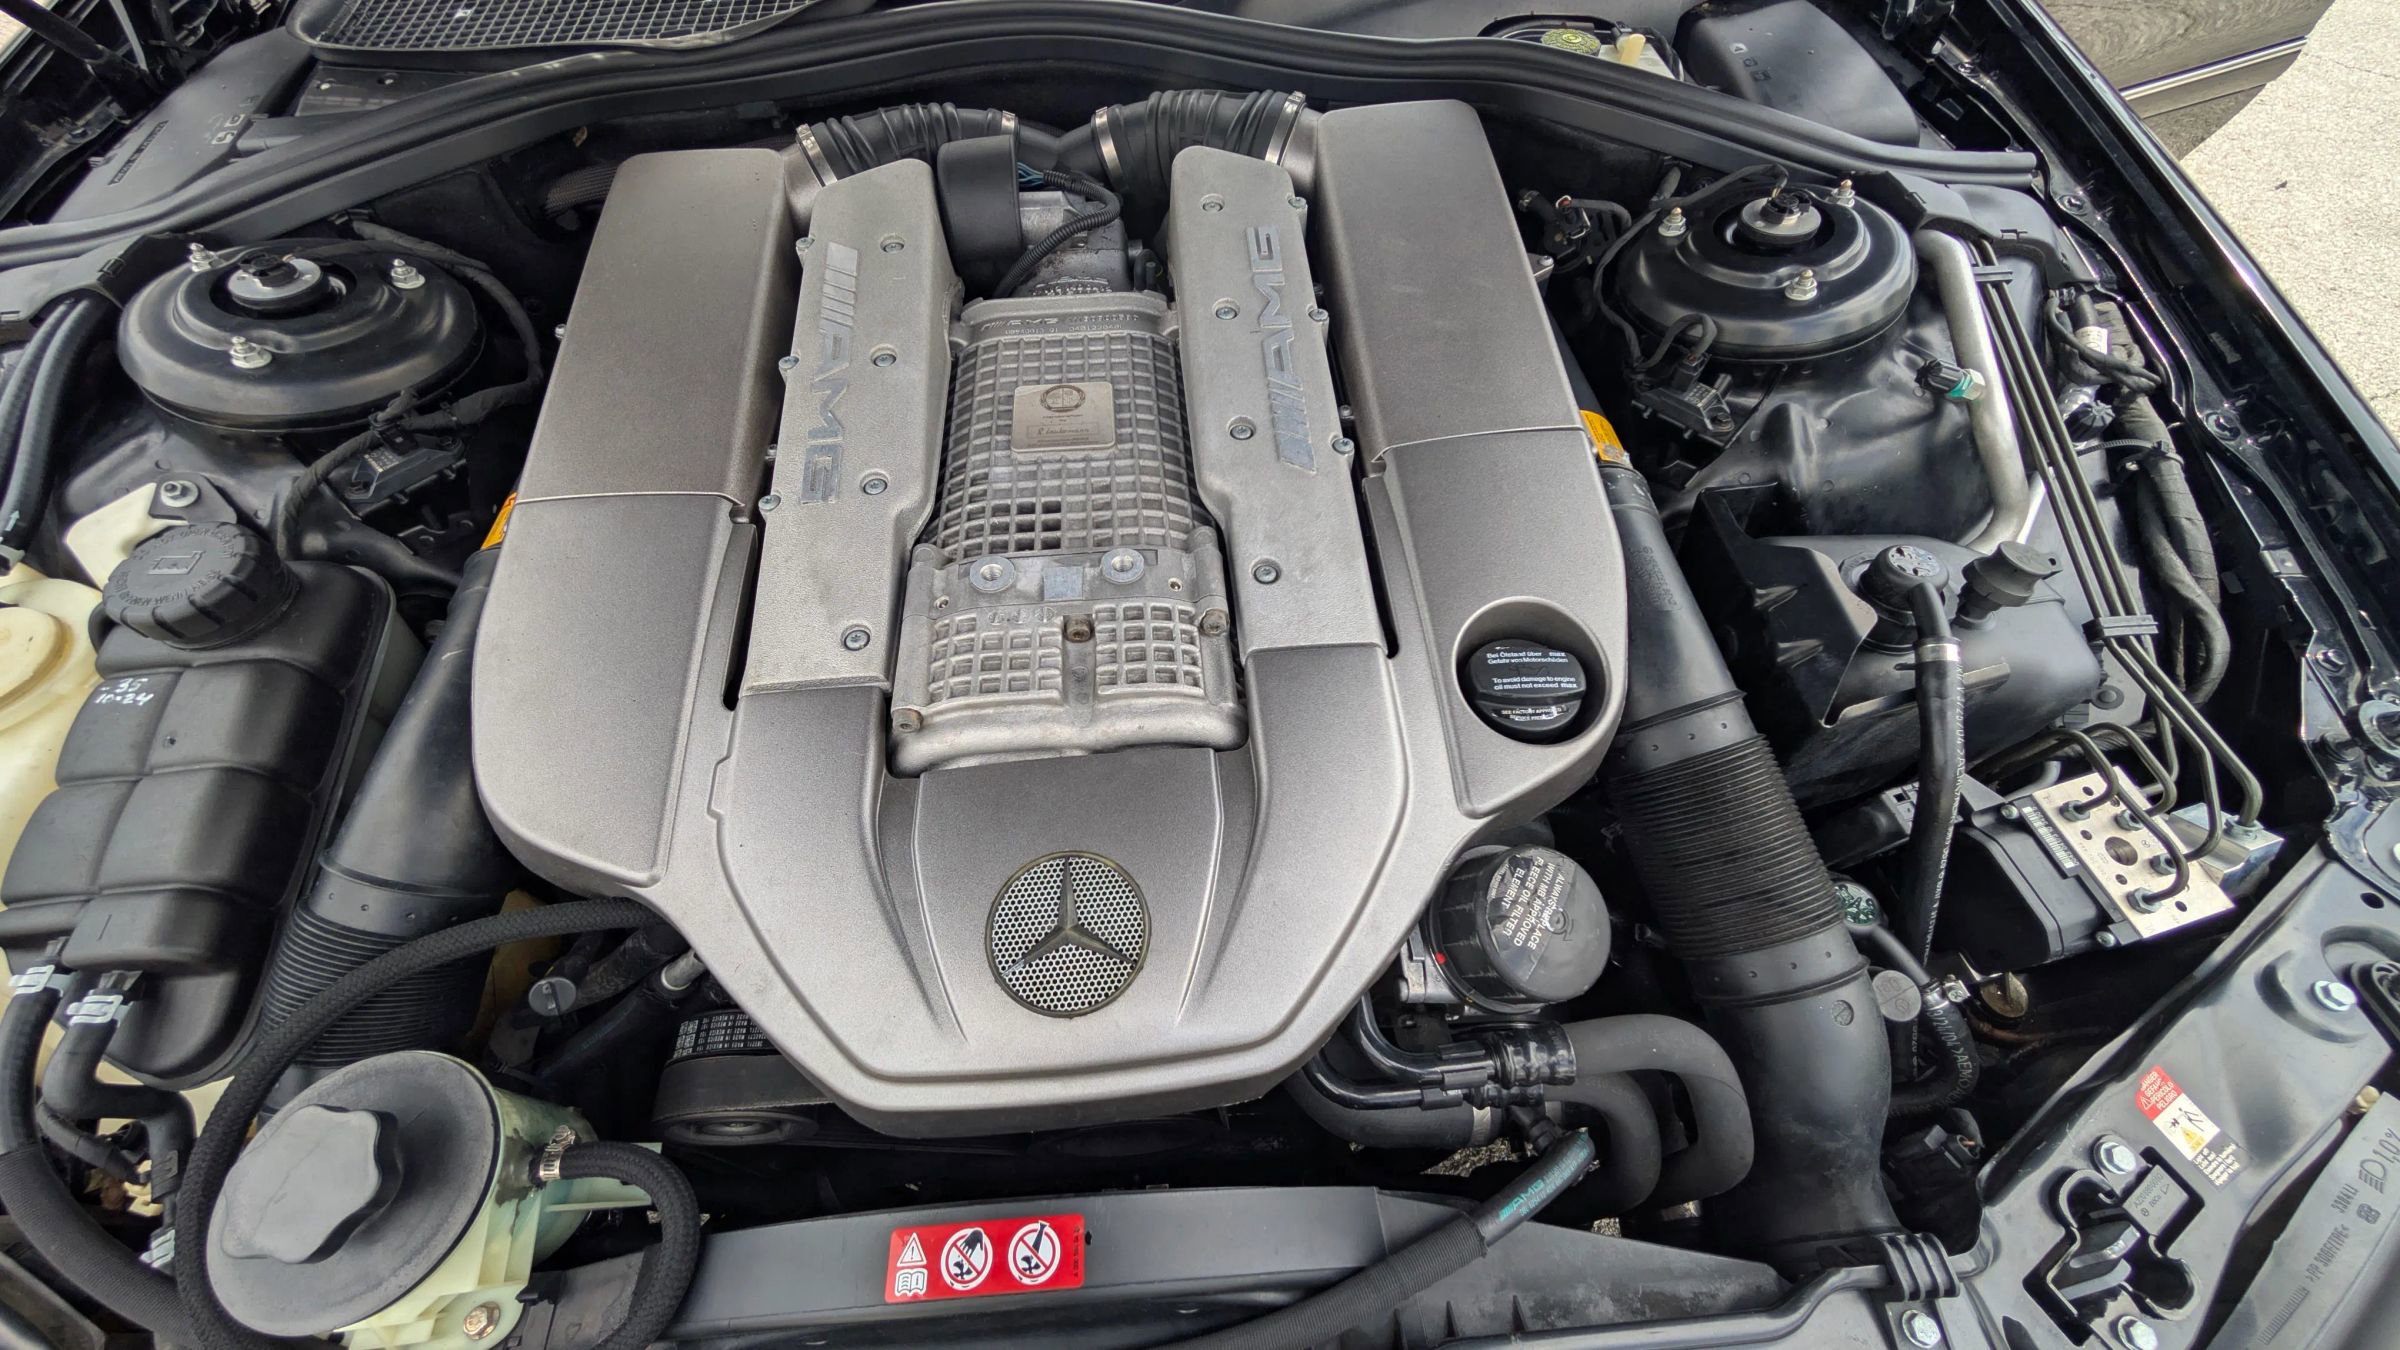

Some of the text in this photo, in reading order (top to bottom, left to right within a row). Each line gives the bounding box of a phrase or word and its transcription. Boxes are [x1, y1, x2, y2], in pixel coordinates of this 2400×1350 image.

[800, 318, 855, 504] AMG
[1501, 867, 1525, 909] ELEMENT
[1514, 862, 1555, 946] WITH MB APPROVED
[1519, 889, 1531, 903] OIL
[1547, 873, 1565, 910] ALWAYS
[1502, 904, 1524, 936] FILTER
[2156, 1089, 2177, 1110] PELIGRO
[1511, 1179, 1545, 1210] AMG
